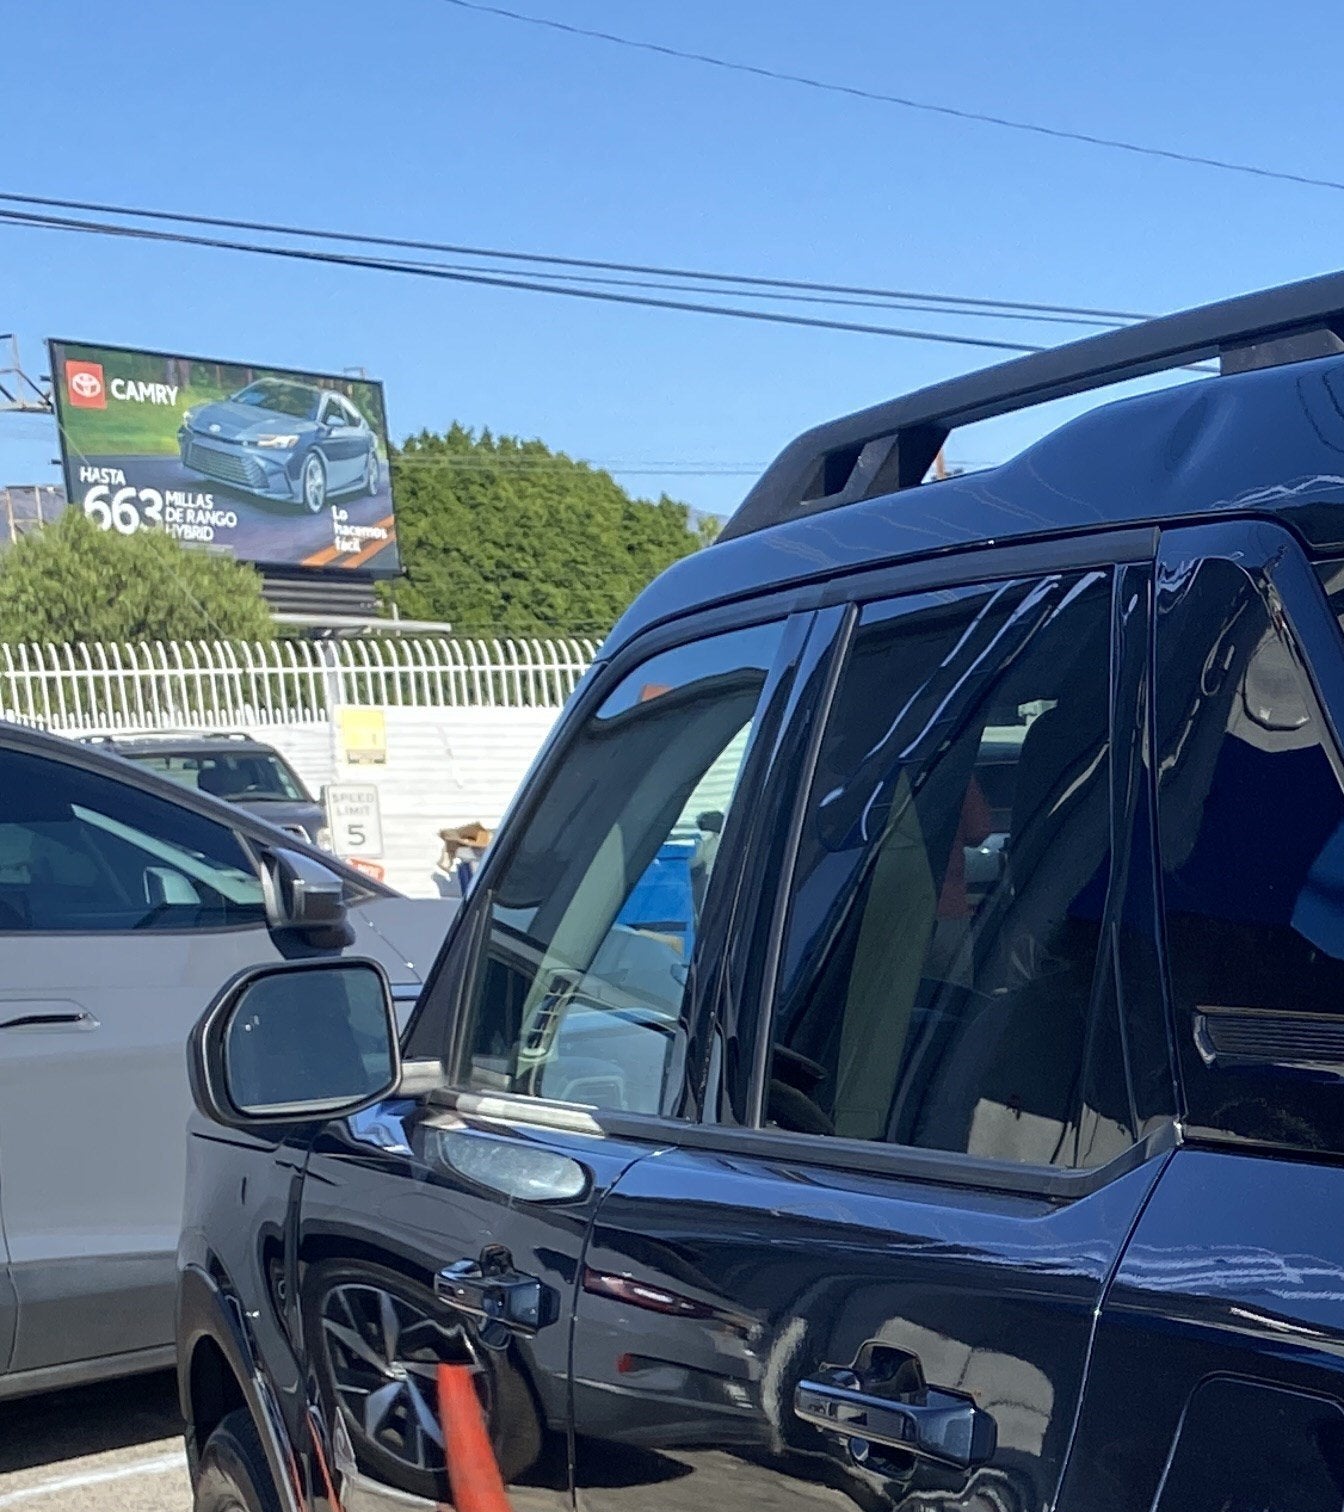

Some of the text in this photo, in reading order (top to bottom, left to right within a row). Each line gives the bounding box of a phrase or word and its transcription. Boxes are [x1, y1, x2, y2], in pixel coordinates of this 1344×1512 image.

[111, 378, 178, 406] CAMRY
[80, 467, 126, 485] HASTA
[165, 491, 214, 509] MILLAS
[84, 485, 163, 535] 663
[165, 507, 237, 528] DE RANGO
[165, 523, 214, 541] HYBRID
[332, 793, 374, 803] SPEED
[337, 806, 371, 817] LIMIT
[347, 824, 366, 846] 5
